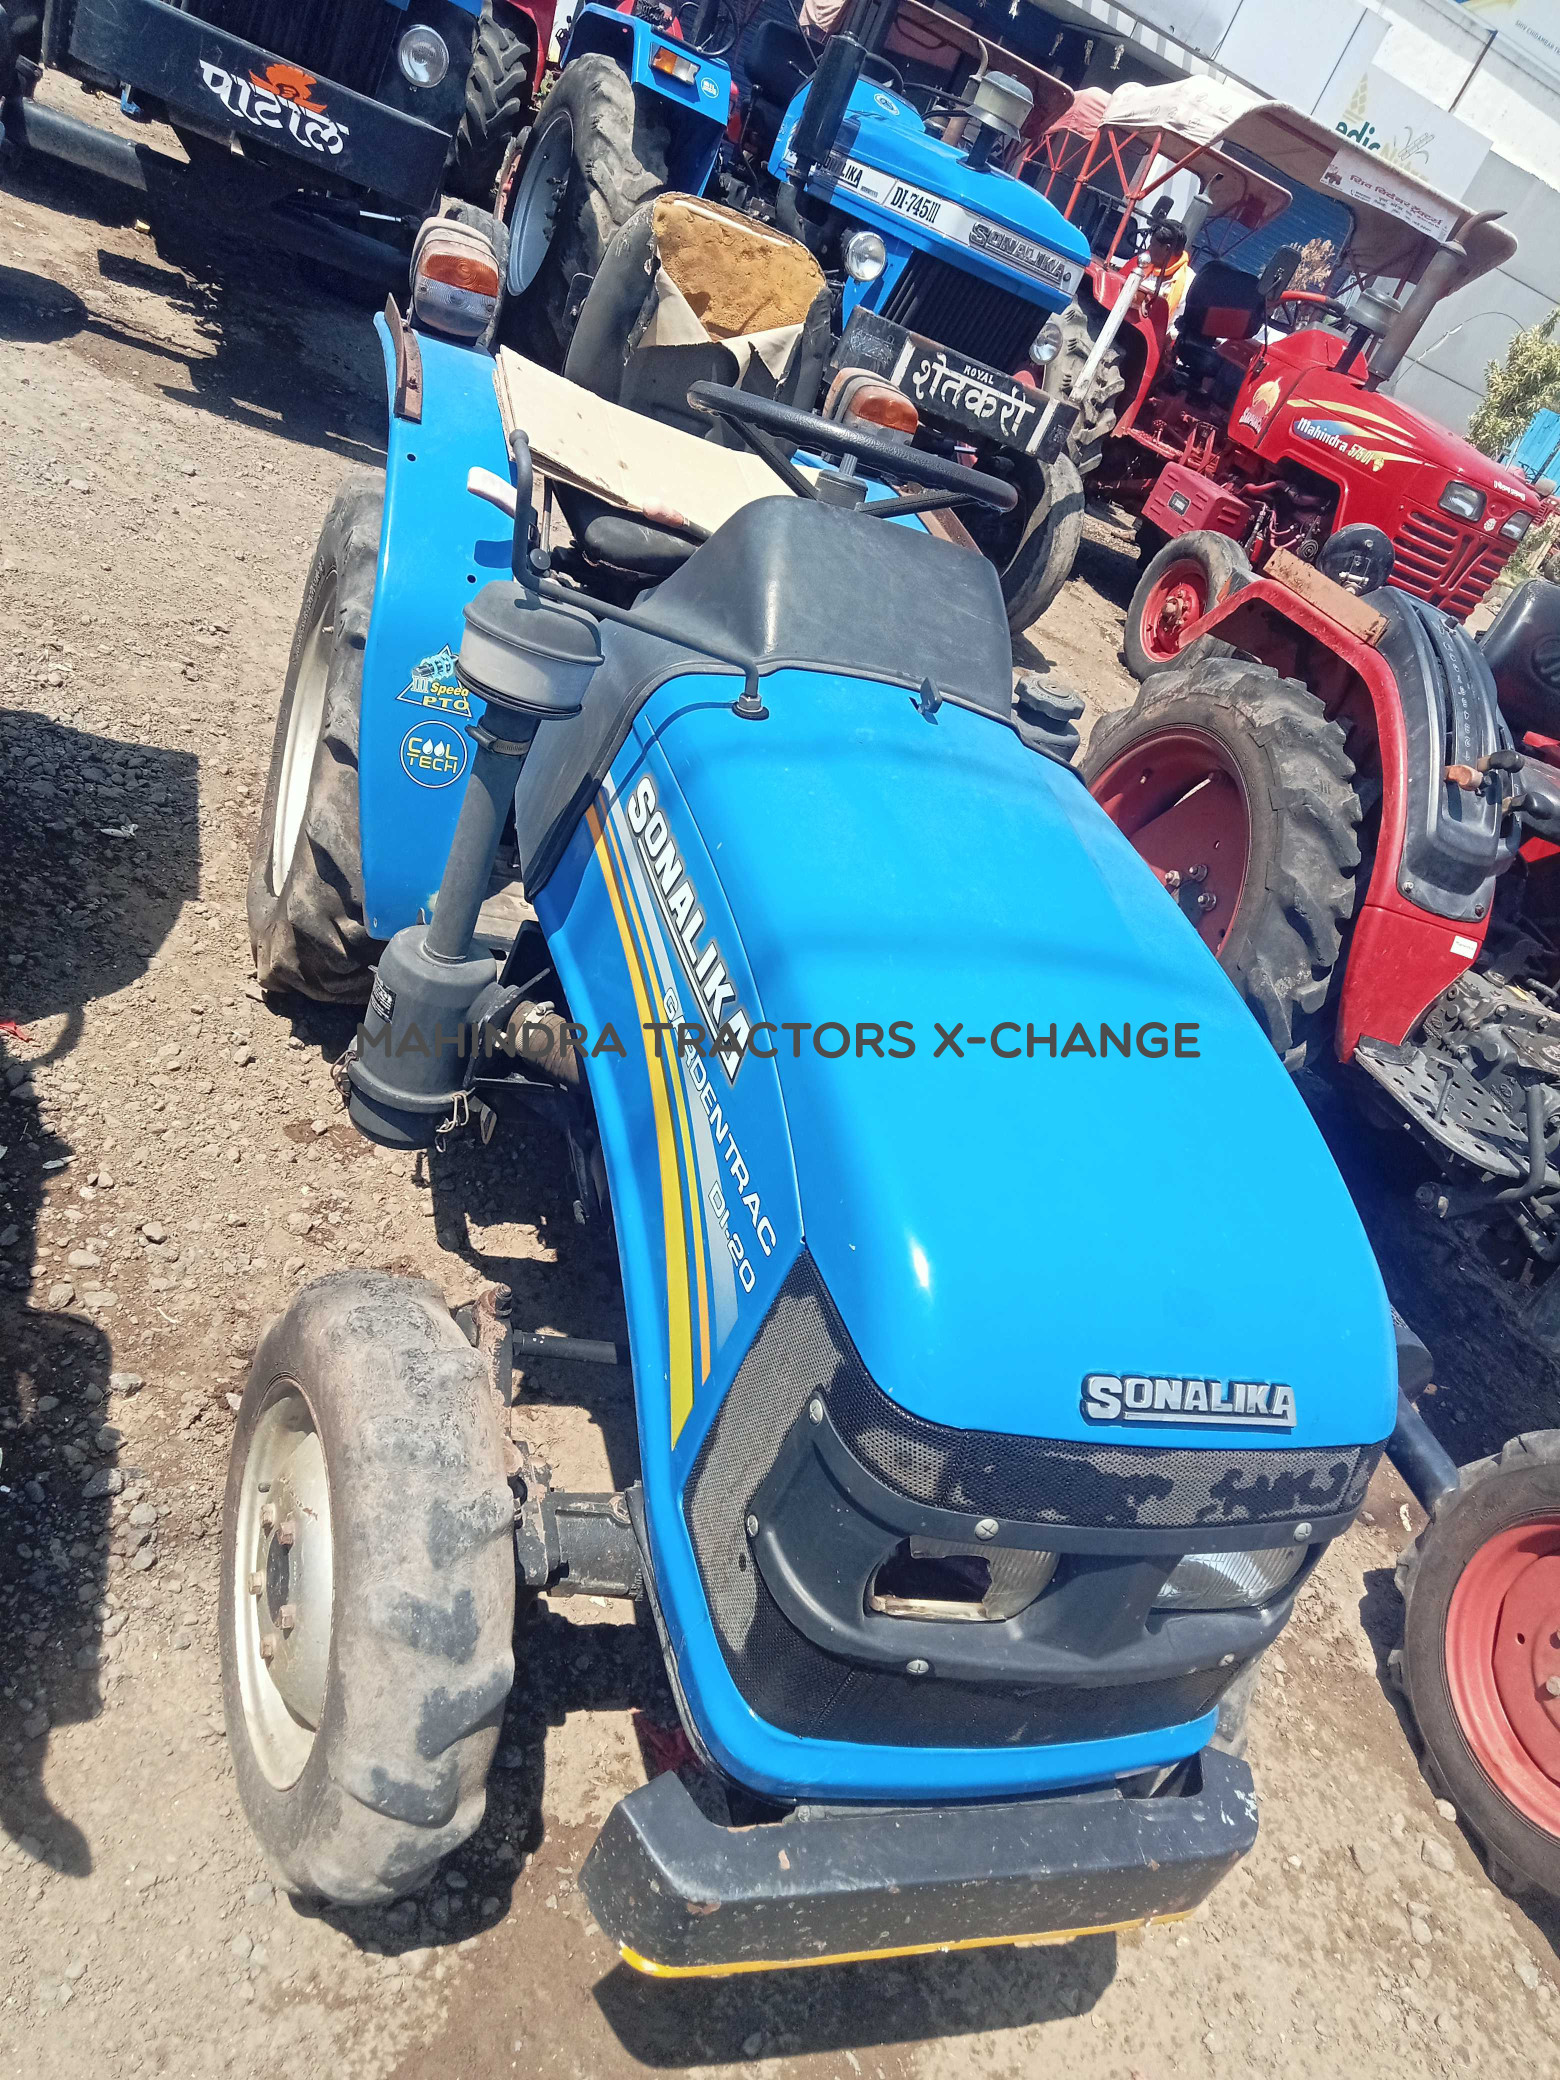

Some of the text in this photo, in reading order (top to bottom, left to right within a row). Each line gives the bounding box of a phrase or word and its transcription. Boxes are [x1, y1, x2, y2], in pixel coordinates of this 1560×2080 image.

[968, 221, 1065, 286] SONALIKA
[963, 364, 994, 385] ROYAL
[1296, 417, 1348, 453] Mahindra
[422, 695, 470, 712] PTO
[406, 752, 458, 774] TECH
[627, 776, 752, 1086] SONALIKA
[1081, 1374, 1297, 1428] SONALIKA
